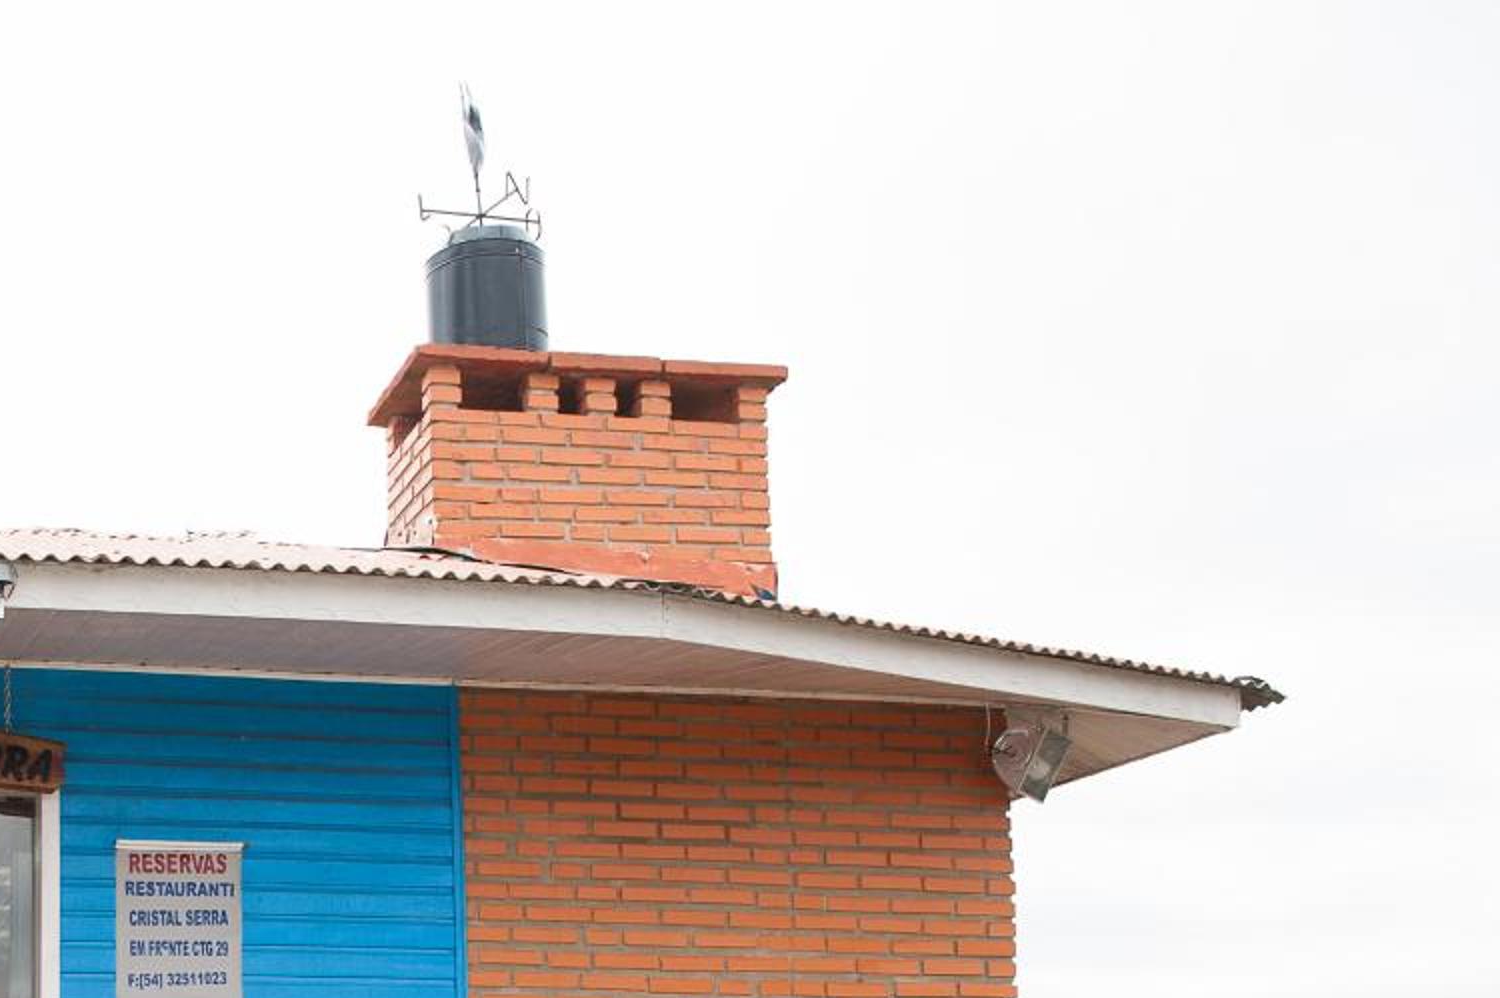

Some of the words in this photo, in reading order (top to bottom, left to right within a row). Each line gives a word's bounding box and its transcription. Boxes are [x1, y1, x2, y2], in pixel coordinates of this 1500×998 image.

[129, 853, 227, 874] RESERVAS
[129, 910, 182, 926] CRISTAL
[185, 911, 229, 926] SERRA
[129, 941, 145, 956] EM
[192, 941, 213, 956] CTG
[215, 941, 229, 956] 29
